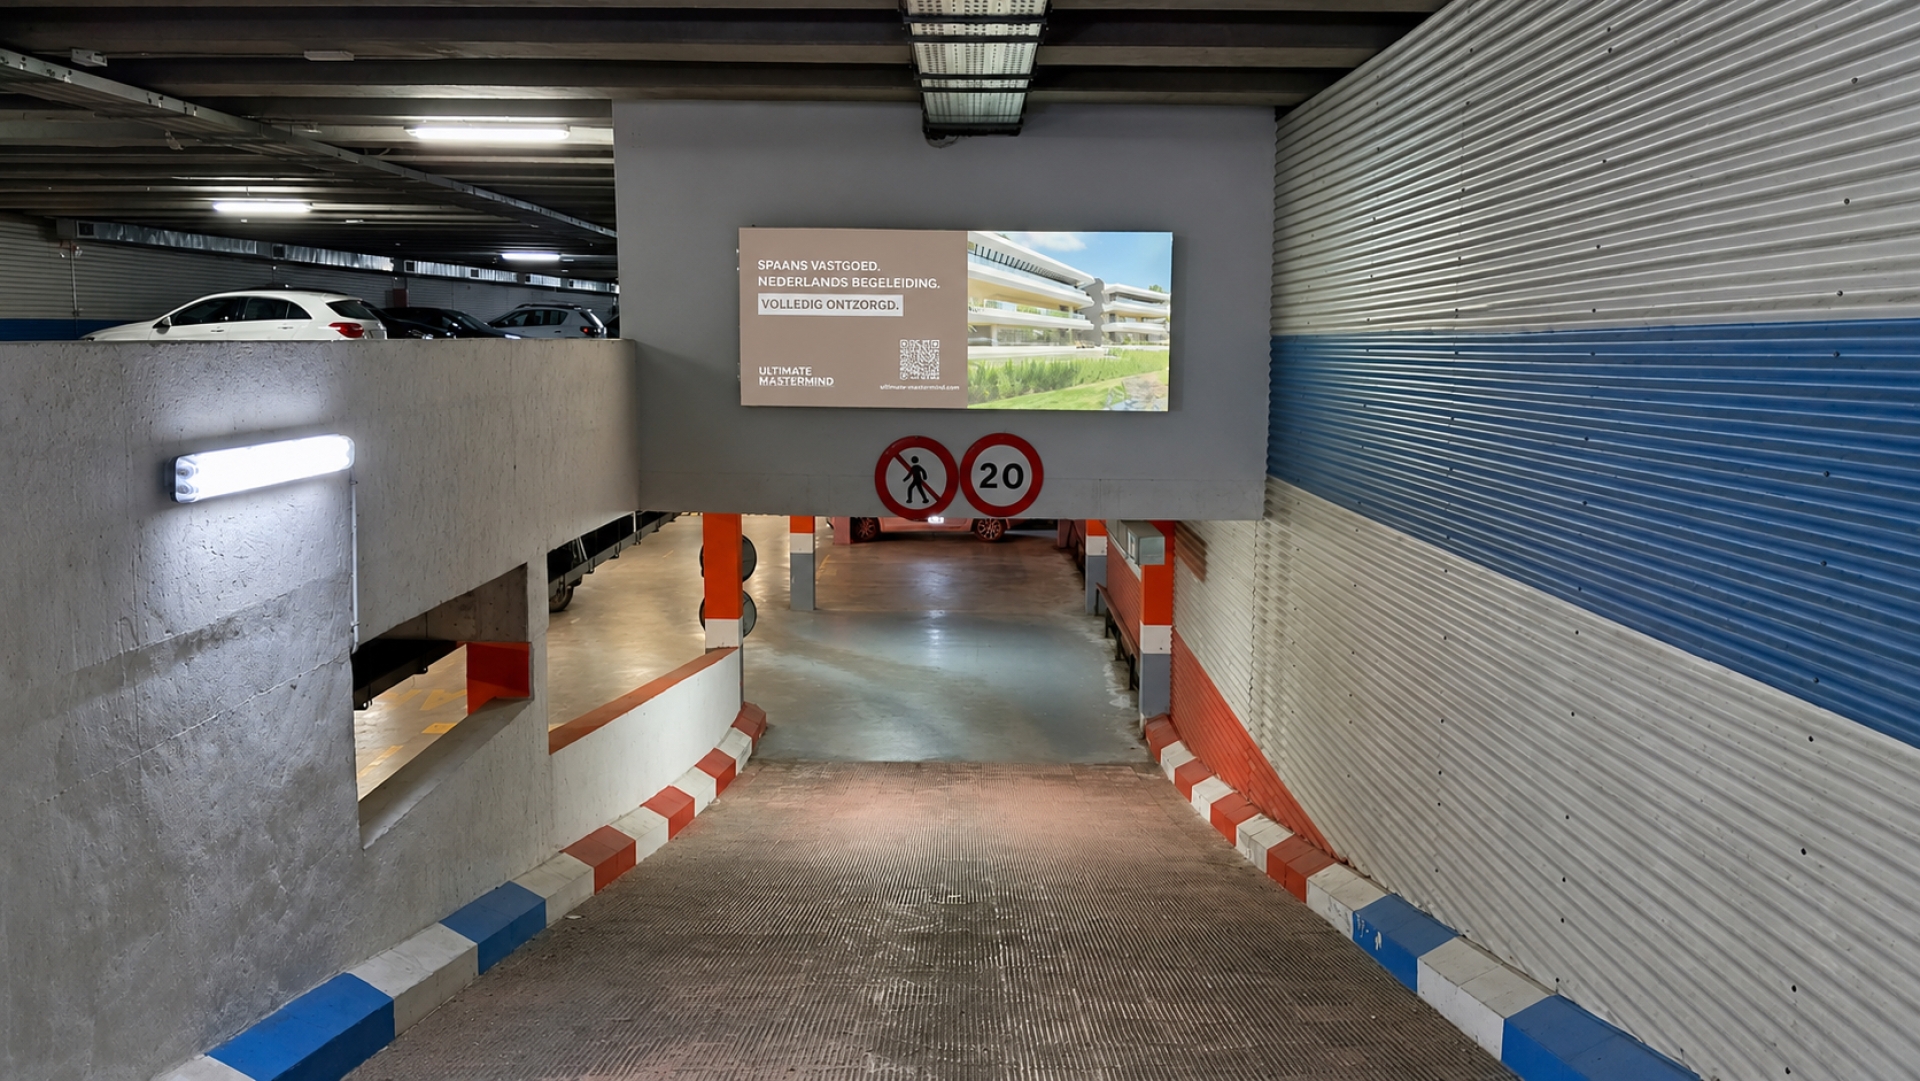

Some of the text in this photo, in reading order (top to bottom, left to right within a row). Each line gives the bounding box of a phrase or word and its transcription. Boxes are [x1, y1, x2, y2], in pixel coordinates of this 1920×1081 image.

[758, 260, 881, 272] SPAANS VASTGOED.
[758, 276, 941, 289] NEDERLANDS BEGELEIDING.
[761, 299, 900, 311] VOLLEDIG ONTZORGD.
[758, 366, 813, 376] ULTIMATE
[758, 376, 835, 387] MASTERMIND
[979, 462, 1024, 490] 20
